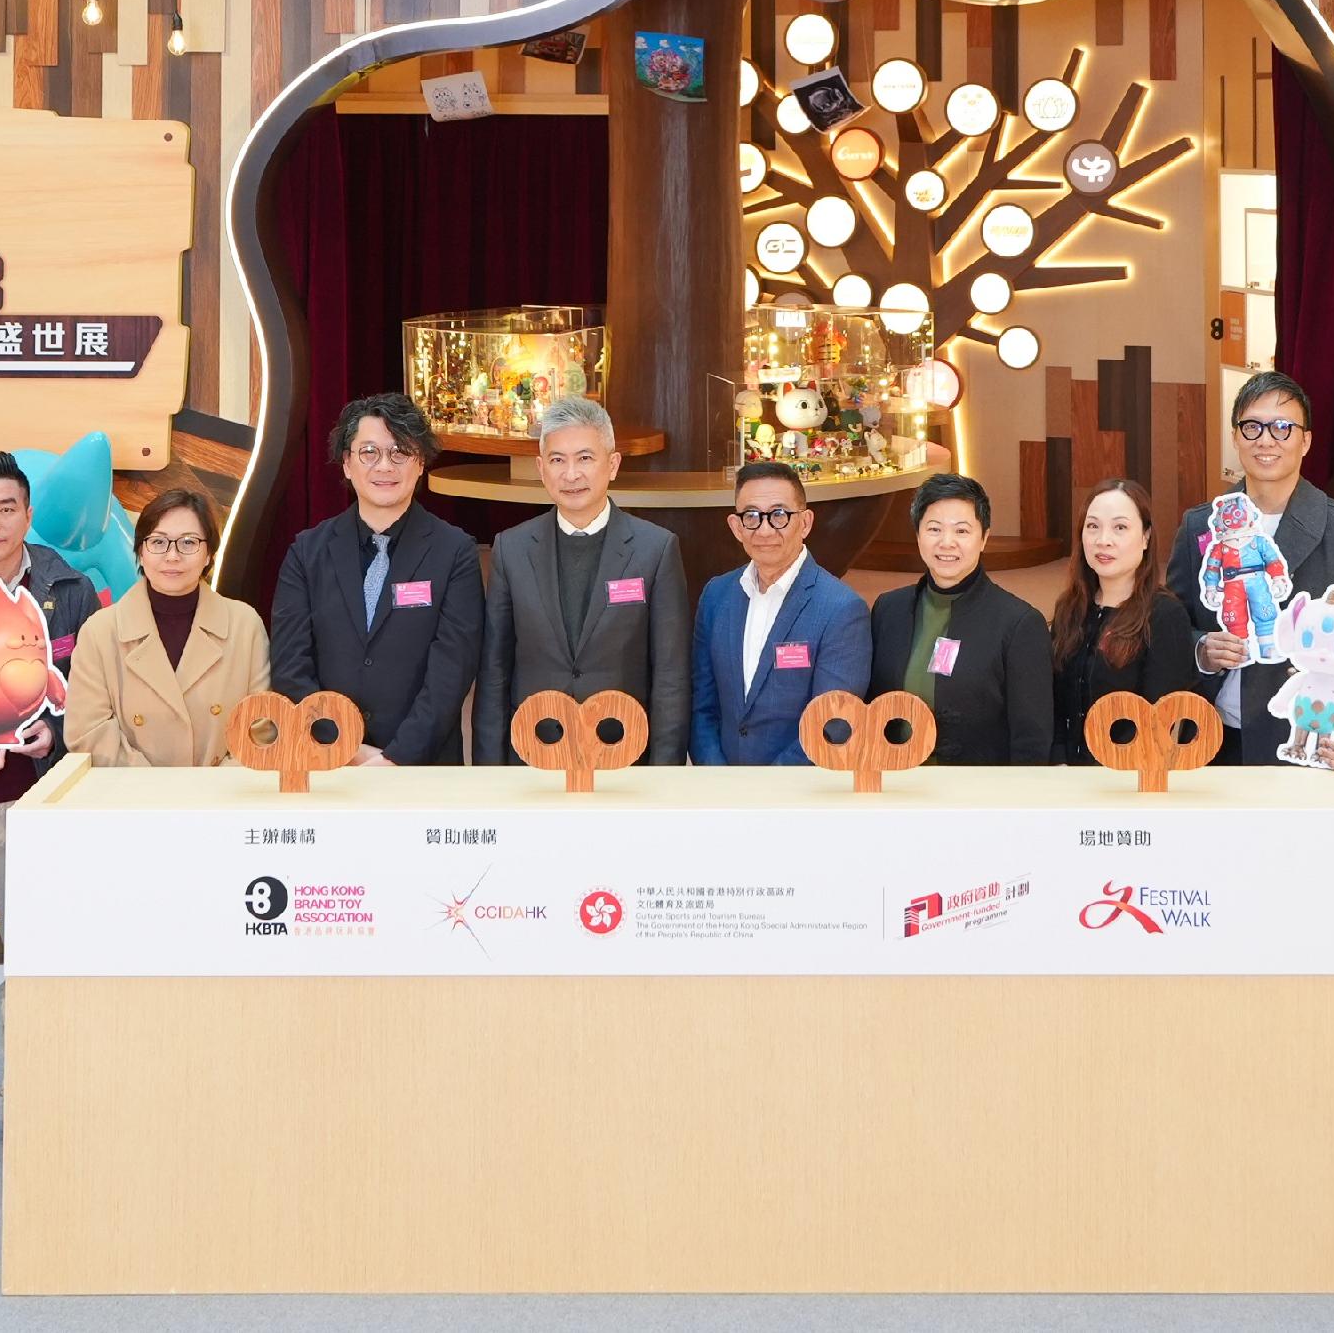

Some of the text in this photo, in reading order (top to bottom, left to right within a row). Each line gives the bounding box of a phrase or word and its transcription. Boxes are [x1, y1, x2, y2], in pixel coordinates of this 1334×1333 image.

[245, 828, 315, 845] 主辦機構
[426, 828, 497, 845] 贊助機構
[1079, 829, 1151, 846] 場地贊助
[294, 886, 365, 896] HONG KONG
[1139, 886, 1211, 906] FESTIVAL
[294, 899, 362, 910] BRAND TOY
[474, 905, 547, 920] CCIDAHK
[294, 912, 373, 923] ASSOCIATION
[1161, 908, 1211, 928] WALK
[245, 922, 289, 936] HKBTA
